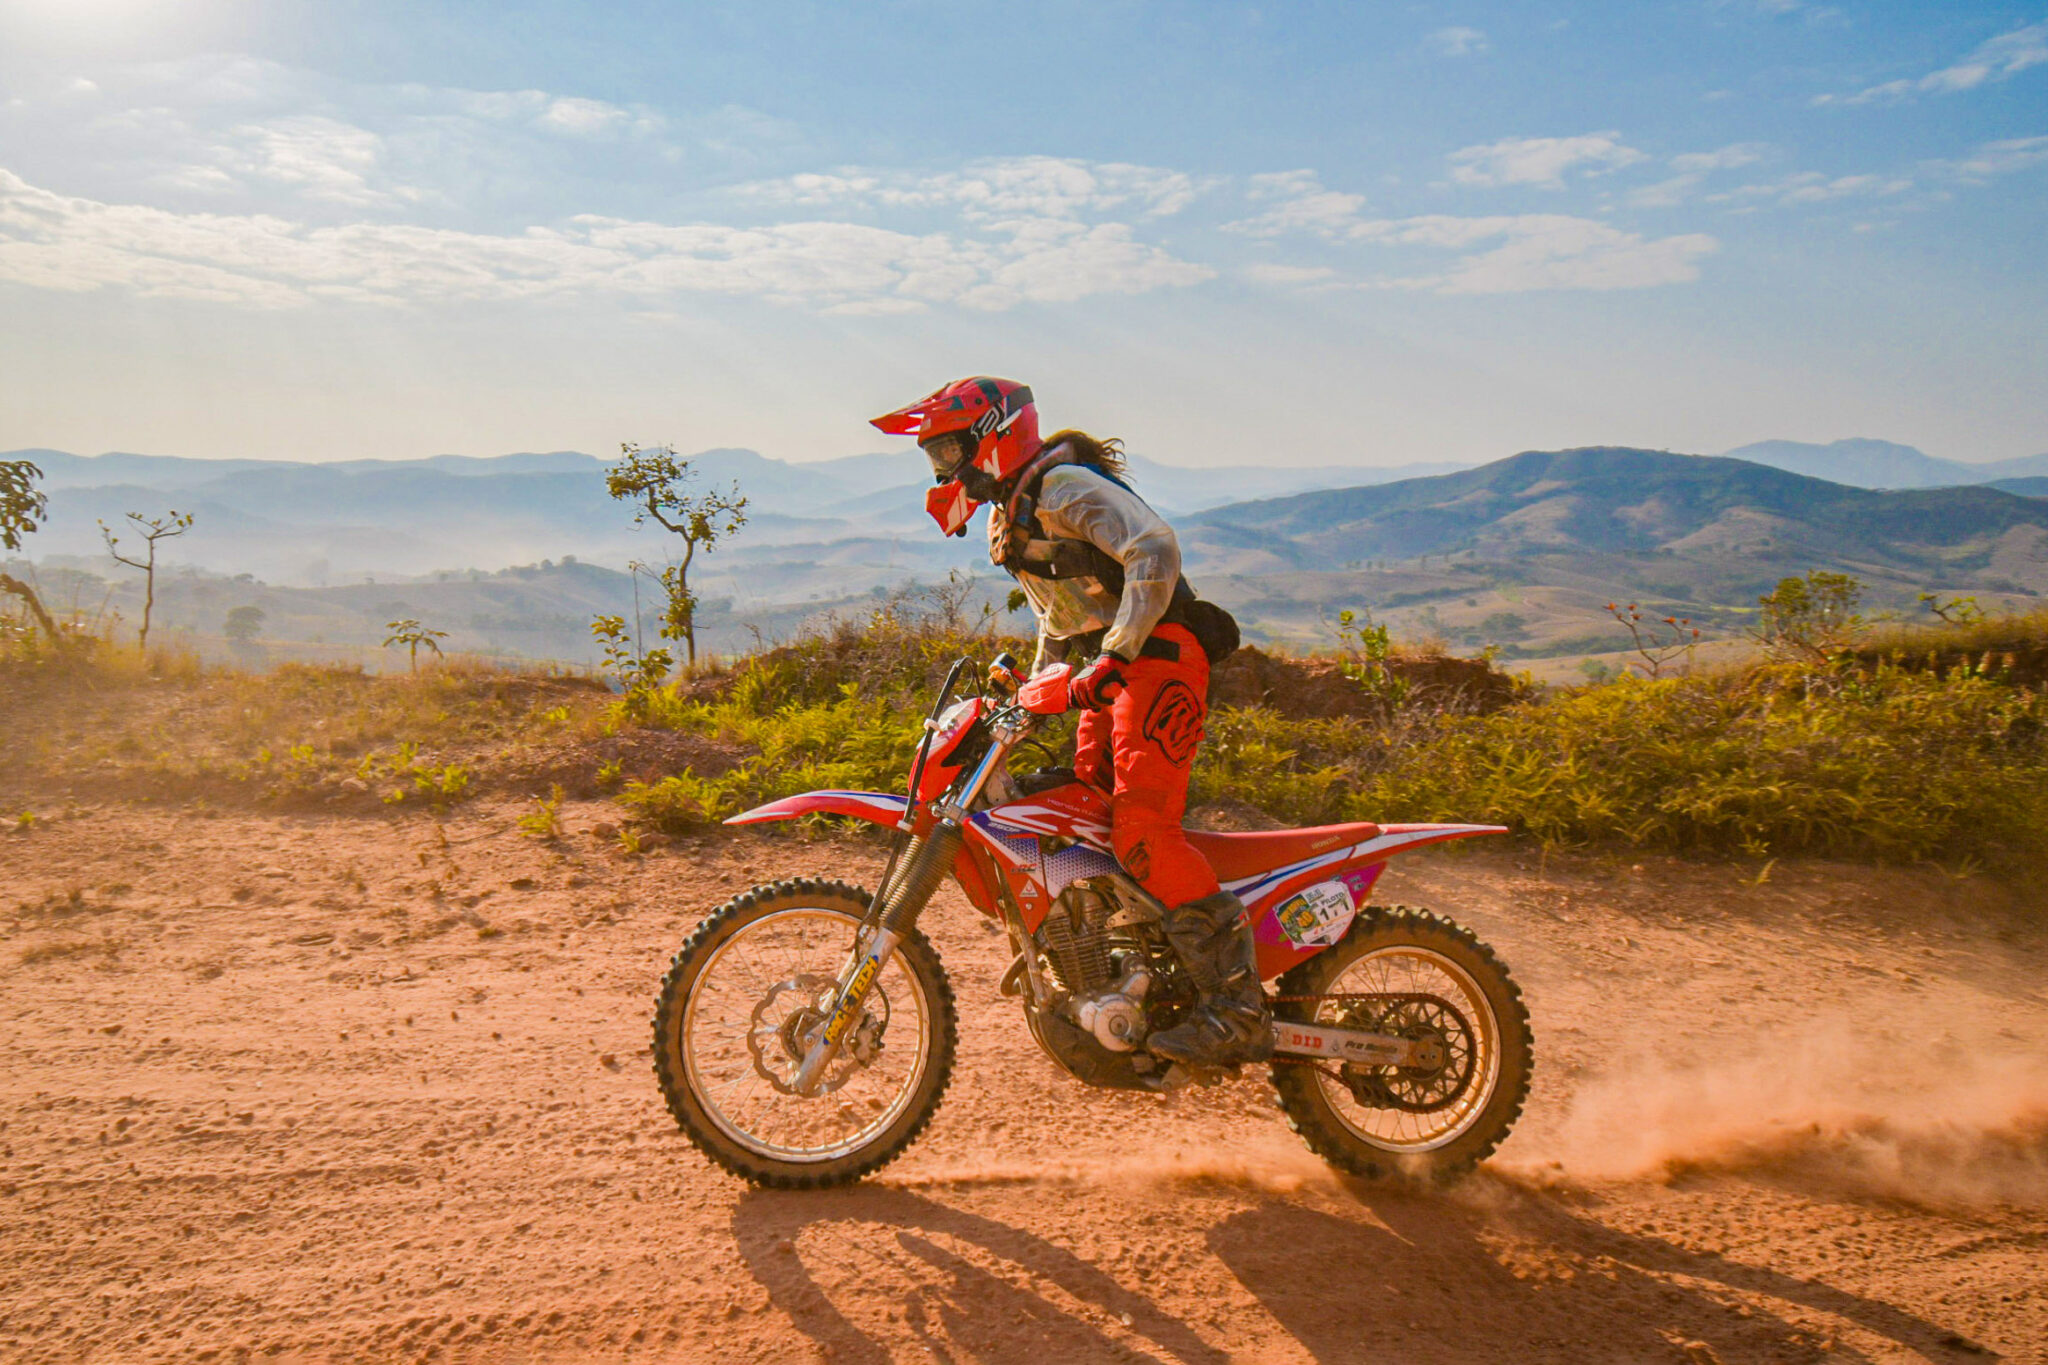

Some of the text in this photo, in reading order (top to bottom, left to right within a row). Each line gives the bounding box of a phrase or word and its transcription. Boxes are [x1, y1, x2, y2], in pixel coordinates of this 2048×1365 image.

[1320, 892, 1345, 905] PILOTO
[824, 956, 878, 1043] RACE TECH
